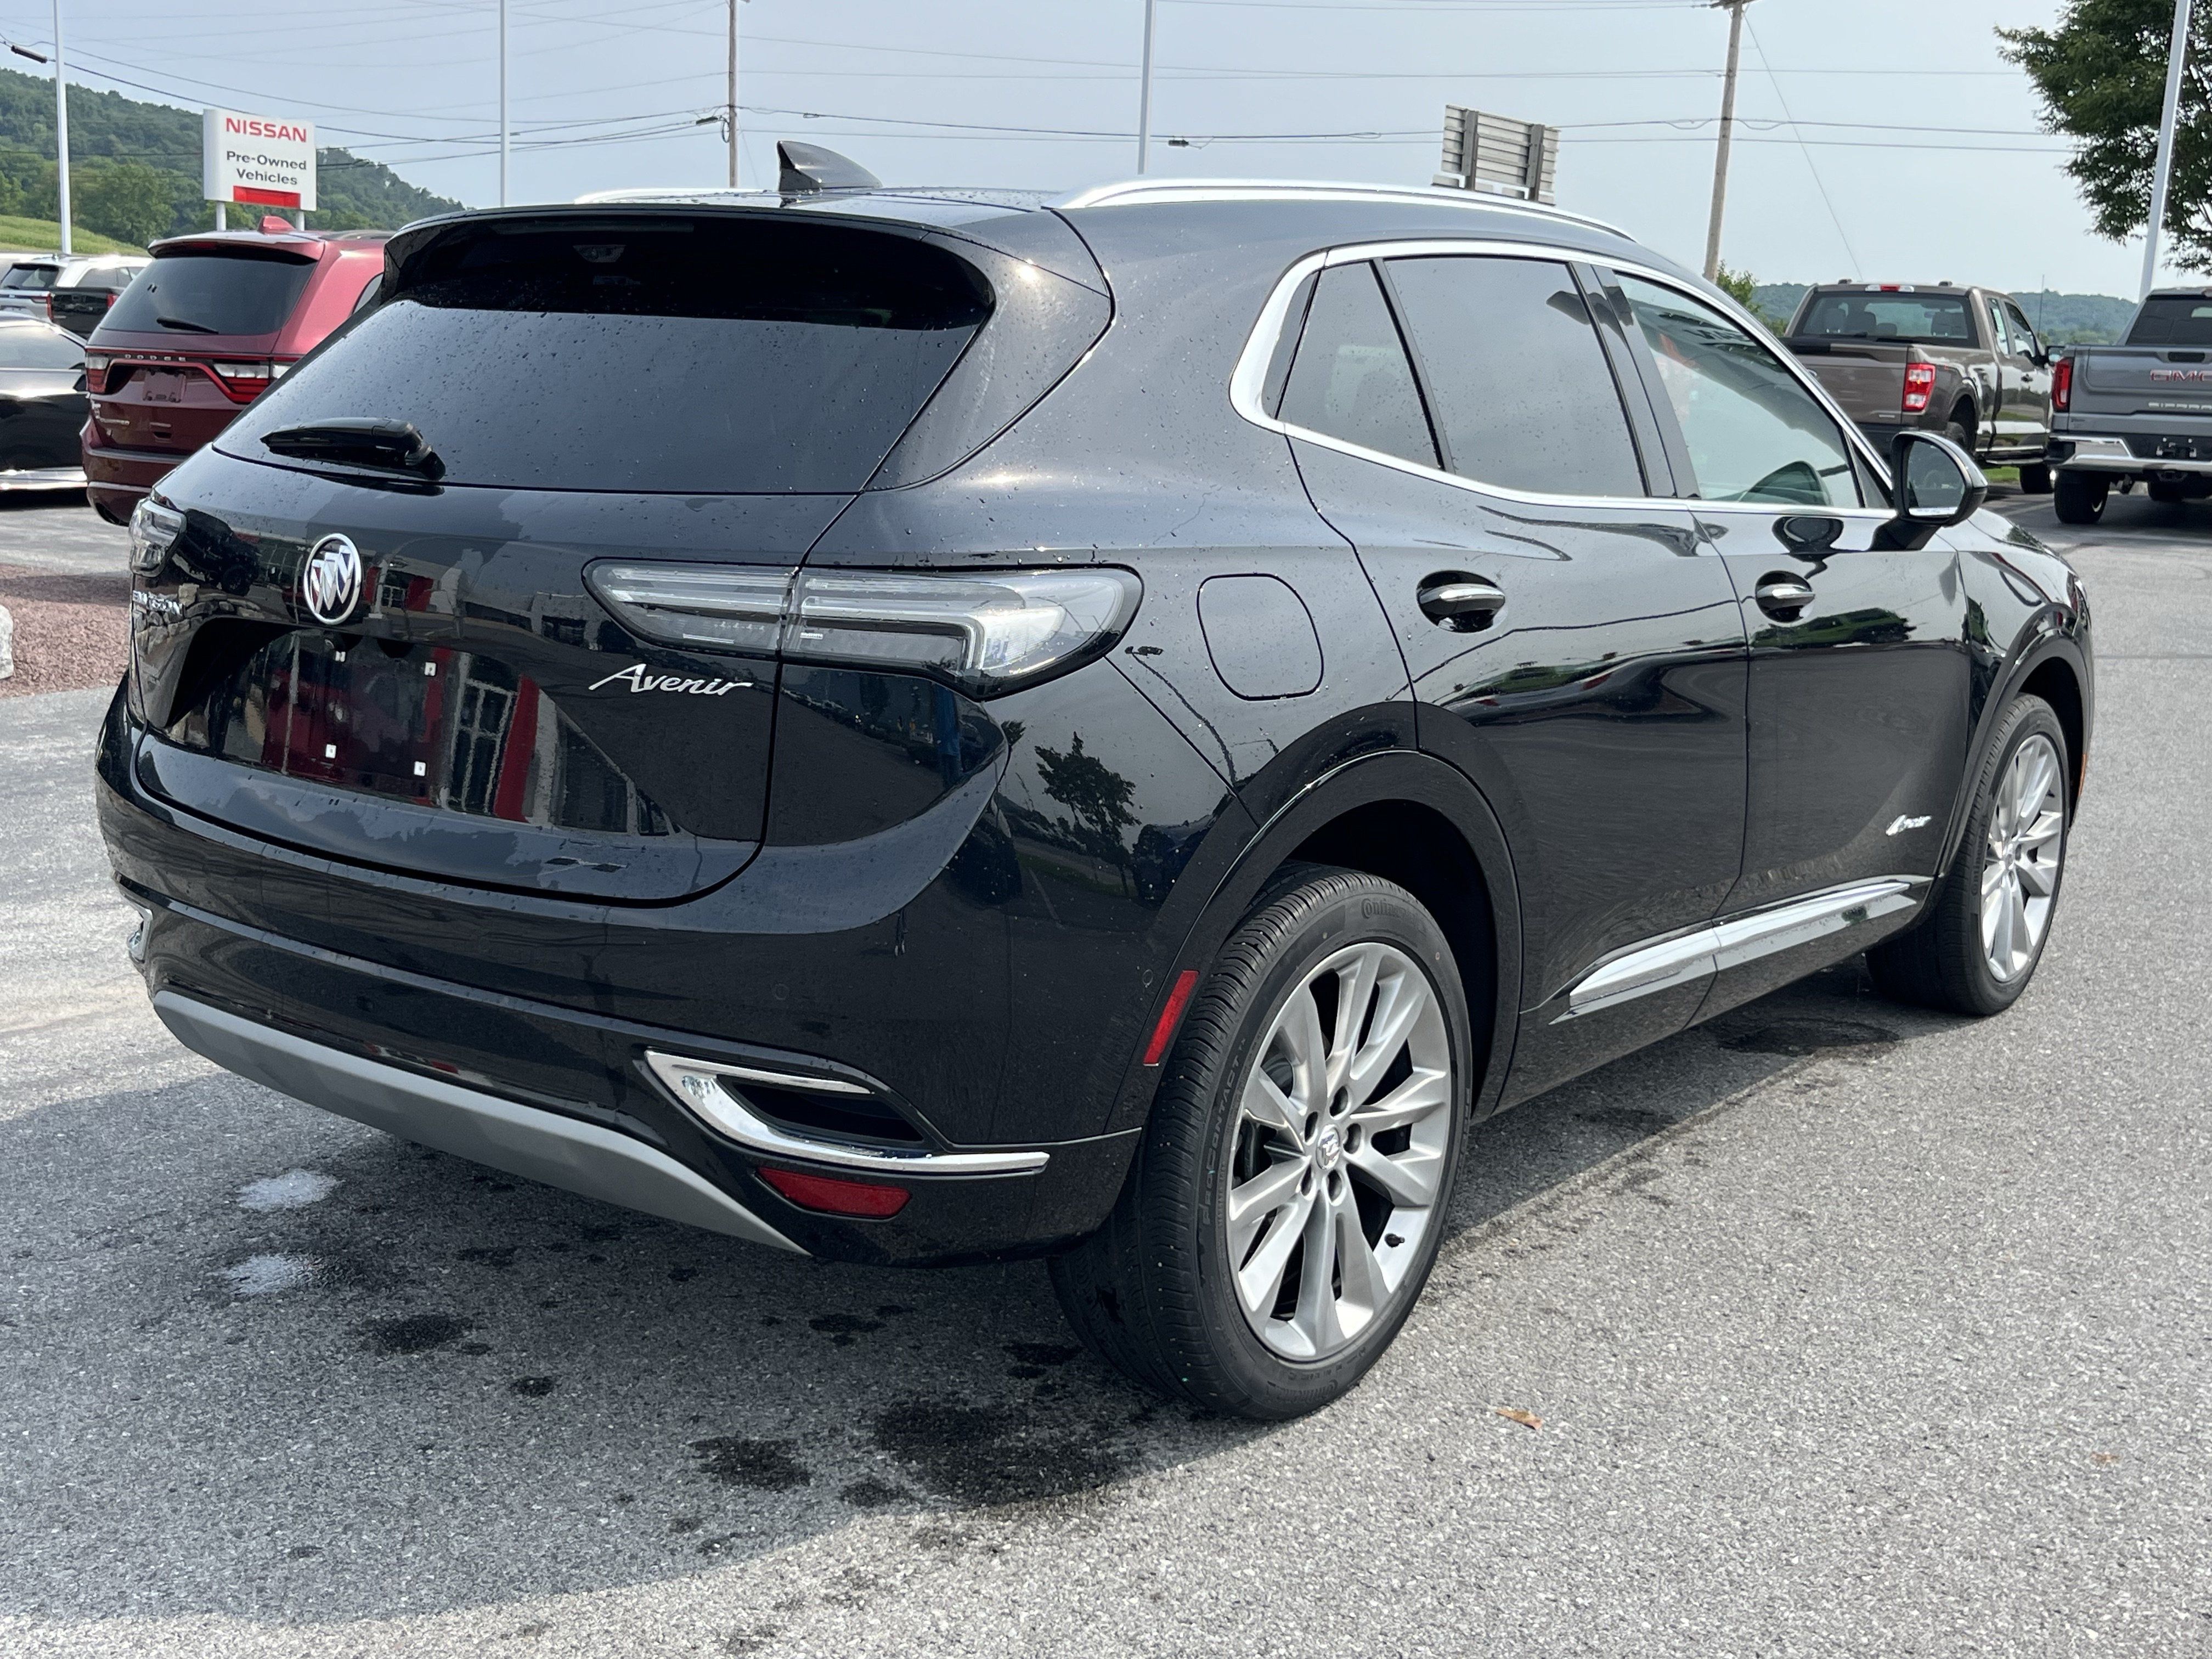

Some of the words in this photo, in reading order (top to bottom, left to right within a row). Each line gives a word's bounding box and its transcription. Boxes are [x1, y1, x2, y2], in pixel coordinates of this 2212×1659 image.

[226, 117, 307, 143] NISSAN
[227, 151, 307, 170] Pre-Owned
[236, 168, 297, 185] Vehicles
[125, 354, 186, 362] DODGE
[589, 663, 754, 696] Avenir
